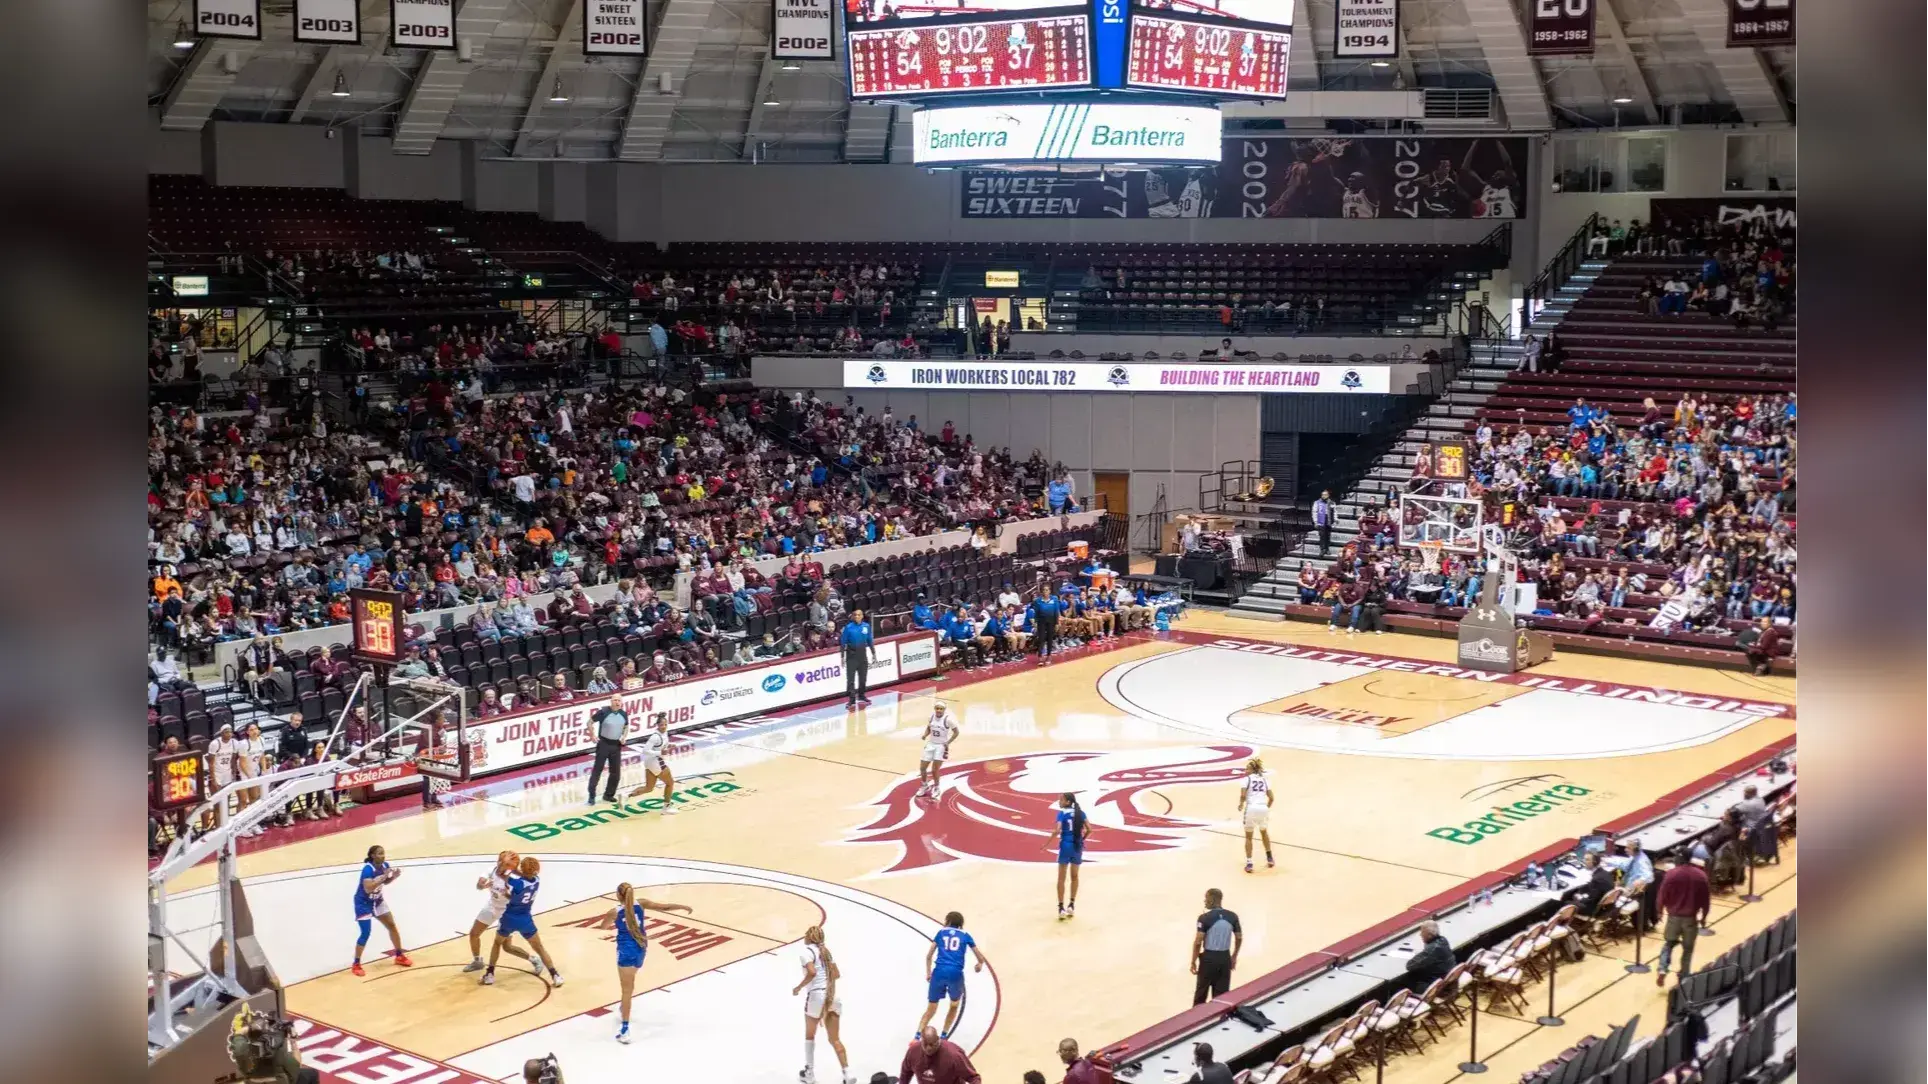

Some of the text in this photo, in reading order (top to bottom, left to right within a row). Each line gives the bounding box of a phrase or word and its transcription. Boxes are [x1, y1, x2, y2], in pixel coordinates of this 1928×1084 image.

[599, 4, 631, 14] SWEET
[777, 9, 829, 19] CHAMPIONS
[1342, 8, 1393, 16] TOURNAMENT
[200, 12, 254, 27] 2004
[301, 18, 353, 33] 2003
[595, 16, 636, 26] SIXTEEN
[1341, 19, 1394, 28] CHAMPIONS
[1734, 21, 1789, 34] 1964-1967
[399, 24, 450, 38] 2003
[590, 32, 641, 45] 2002
[1535, 30, 1587, 41] 1958-1962
[779, 37, 828, 50] 2002
[936, 26, 988, 54] 9:02
[1195, 28, 1230, 56] 9:02
[1344, 35, 1389, 47] 1994
[897, 51, 922, 75] 54
[1008, 44, 1035, 69] 37
[1164, 44, 1183, 70] 54
[1239, 52, 1257, 76] 37
[942, 73, 991, 86] 3 3 2
[930, 128, 1008, 149] Banterra
[1091, 125, 1185, 147] Banterra
[968, 177, 1057, 194] SWEET
[1243, 141, 1267, 218] 2002
[1394, 140, 1420, 218] 2007
[968, 198, 1080, 215] SIXTEEN
[912, 368, 1076, 386] IRON WORKERS LOCAL 782
[1160, 370, 1219, 386] BUILDING
[1223, 371, 1246, 386] THE
[1248, 371, 1321, 387] HEARTLAND
[902, 651, 931, 664] Banterra
[1208, 640, 1510, 682] SOUTHERN
[806, 664, 841, 683] aetna
[1518, 677, 1787, 717] ILLINOIS
[1282, 702, 1412, 727] VALLEY
[496, 711, 583, 743] JOIN THE
[523, 727, 595, 756] DAWG'S
[647, 705, 695, 731] CUB!
[168, 758, 197, 776] 9:02
[170, 777, 191, 800] 30
[1252, 780, 1264, 792] 22
[1425, 783, 1594, 846] Banterra
[942, 936, 960, 951] 10
